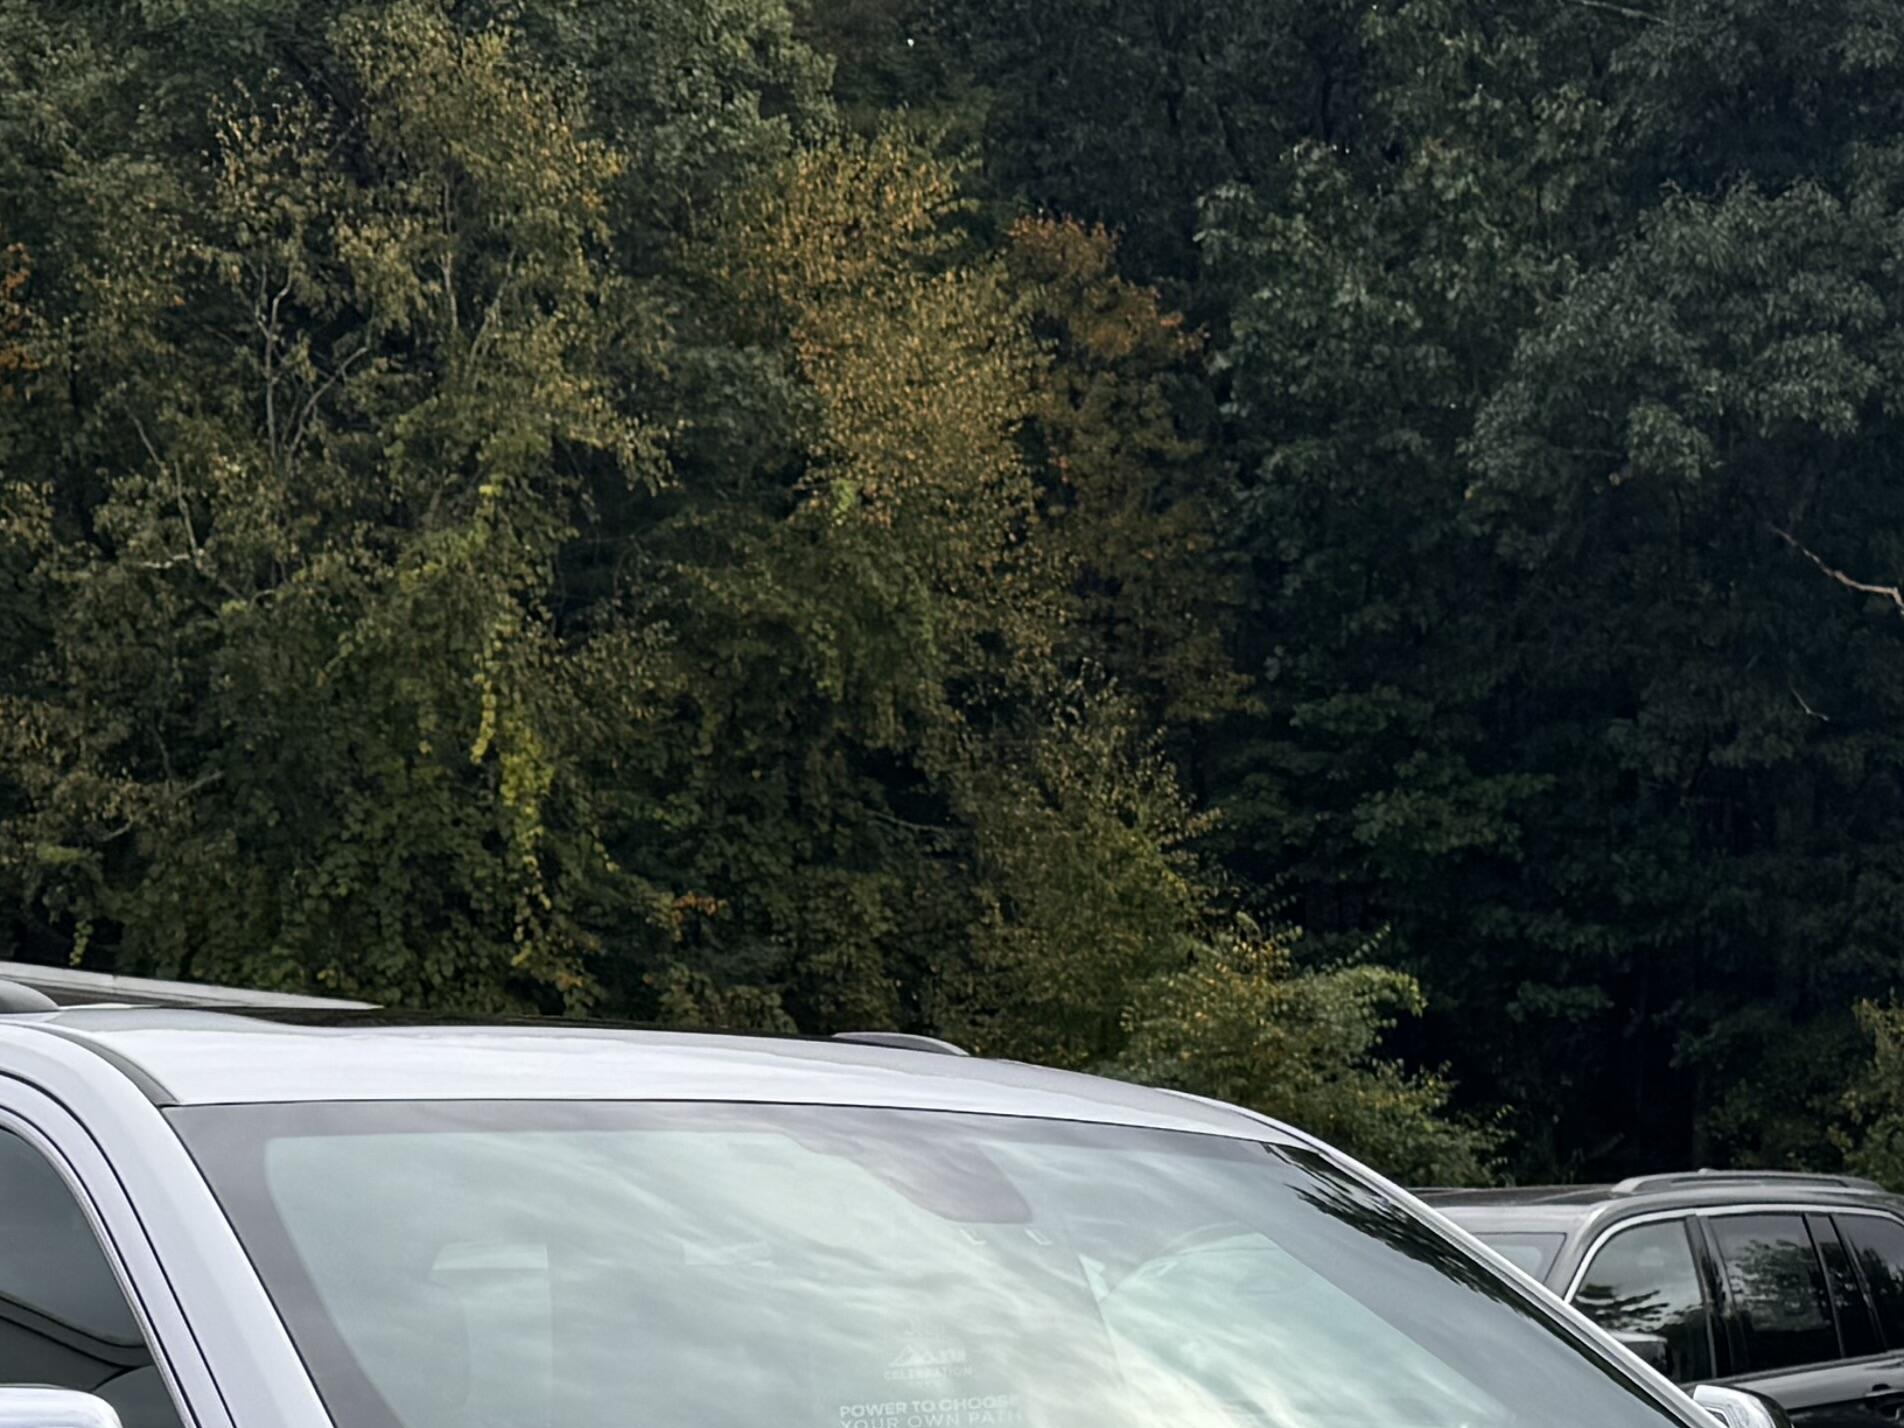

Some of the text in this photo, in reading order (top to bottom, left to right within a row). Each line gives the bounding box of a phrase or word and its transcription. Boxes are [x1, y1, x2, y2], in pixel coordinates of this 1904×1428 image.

[839, 1401, 908, 1419] POWER
[911, 1399, 936, 1413] TO
[907, 1412, 960, 1428] OWN
